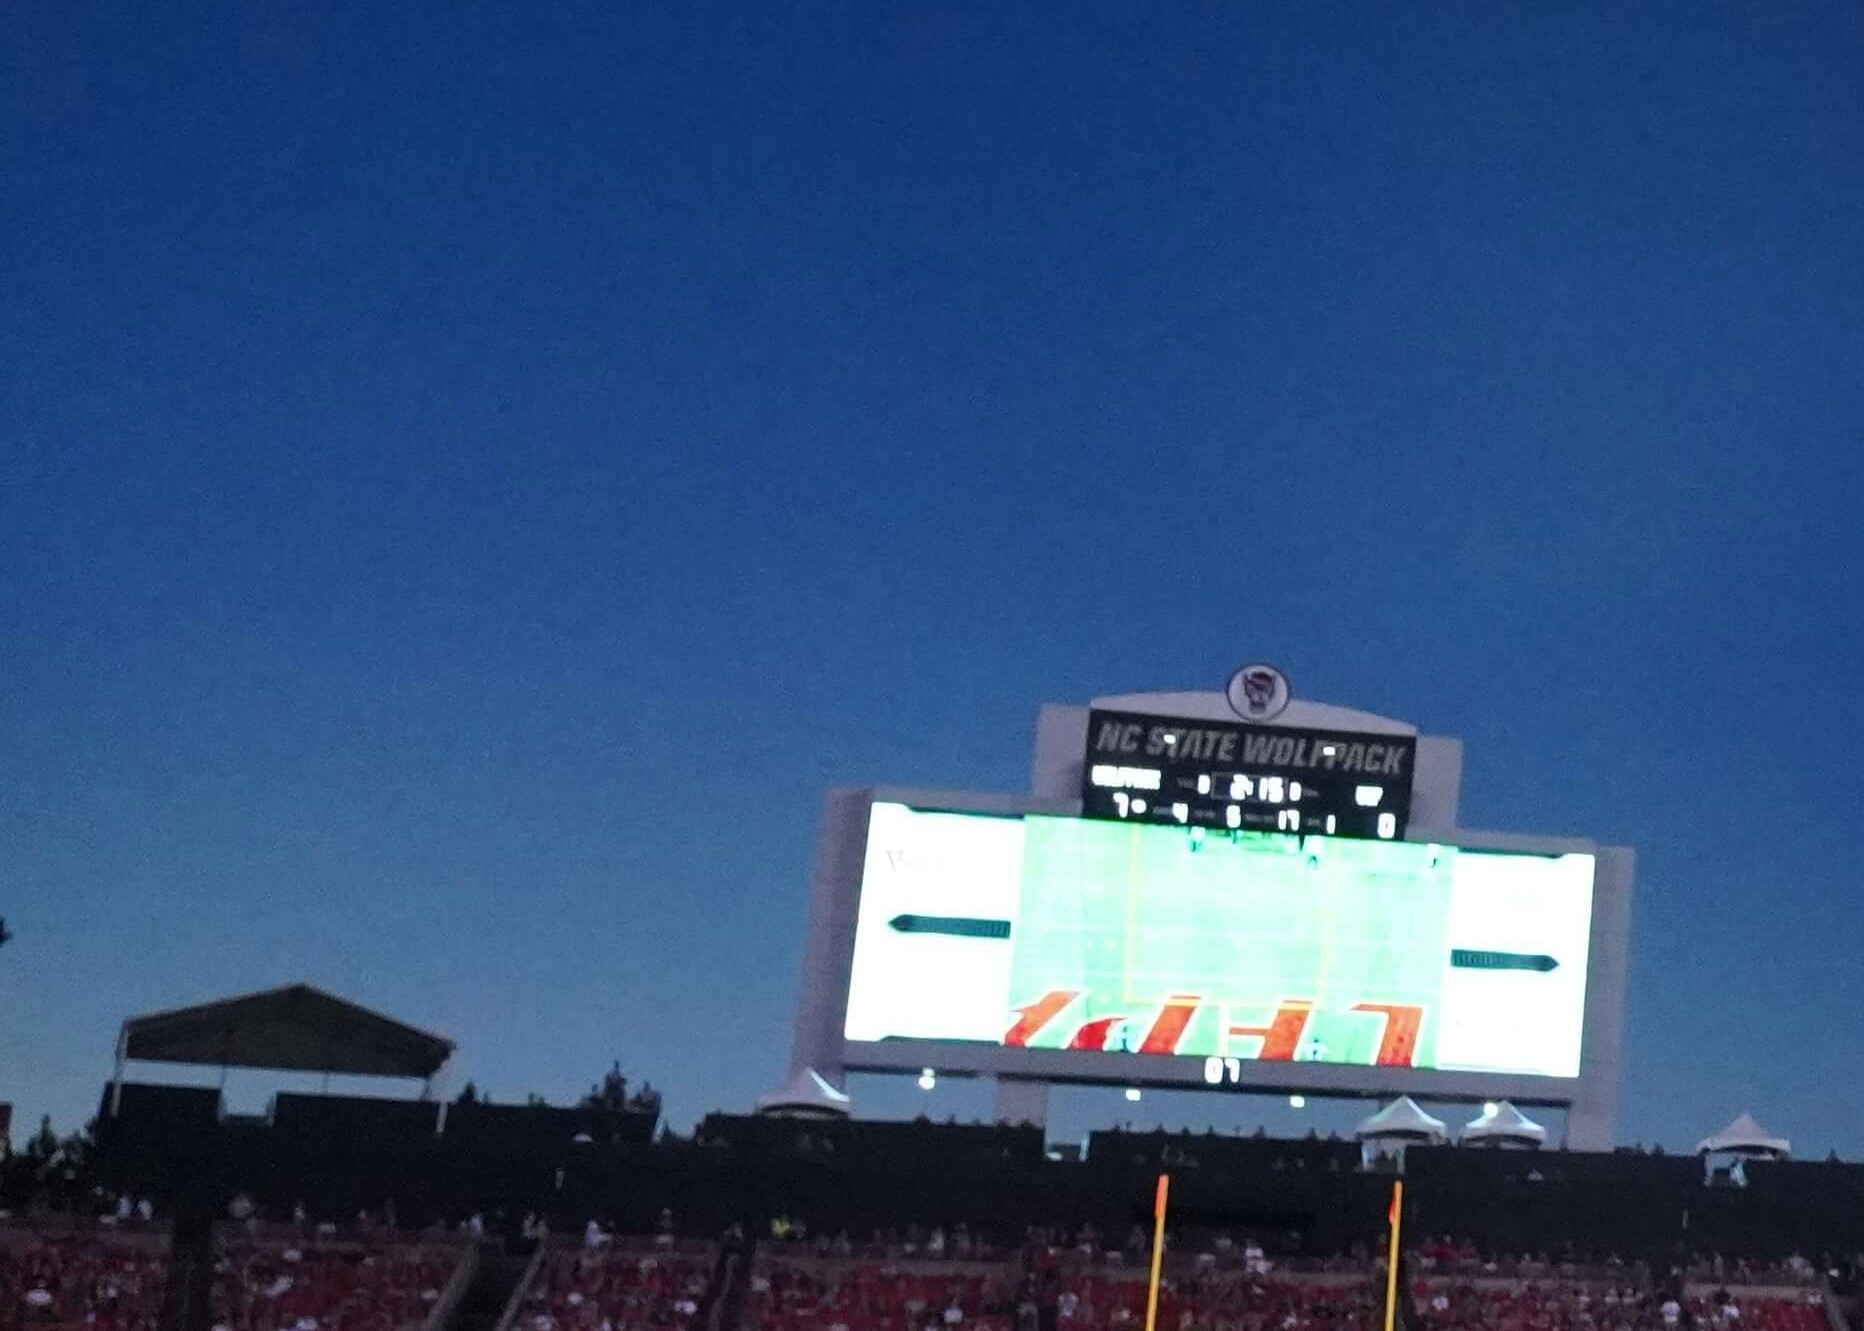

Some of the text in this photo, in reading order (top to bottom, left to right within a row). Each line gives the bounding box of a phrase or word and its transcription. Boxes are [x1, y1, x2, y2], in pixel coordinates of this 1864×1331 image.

[1096, 722, 1408, 775] NC STATE WOLFPACK
